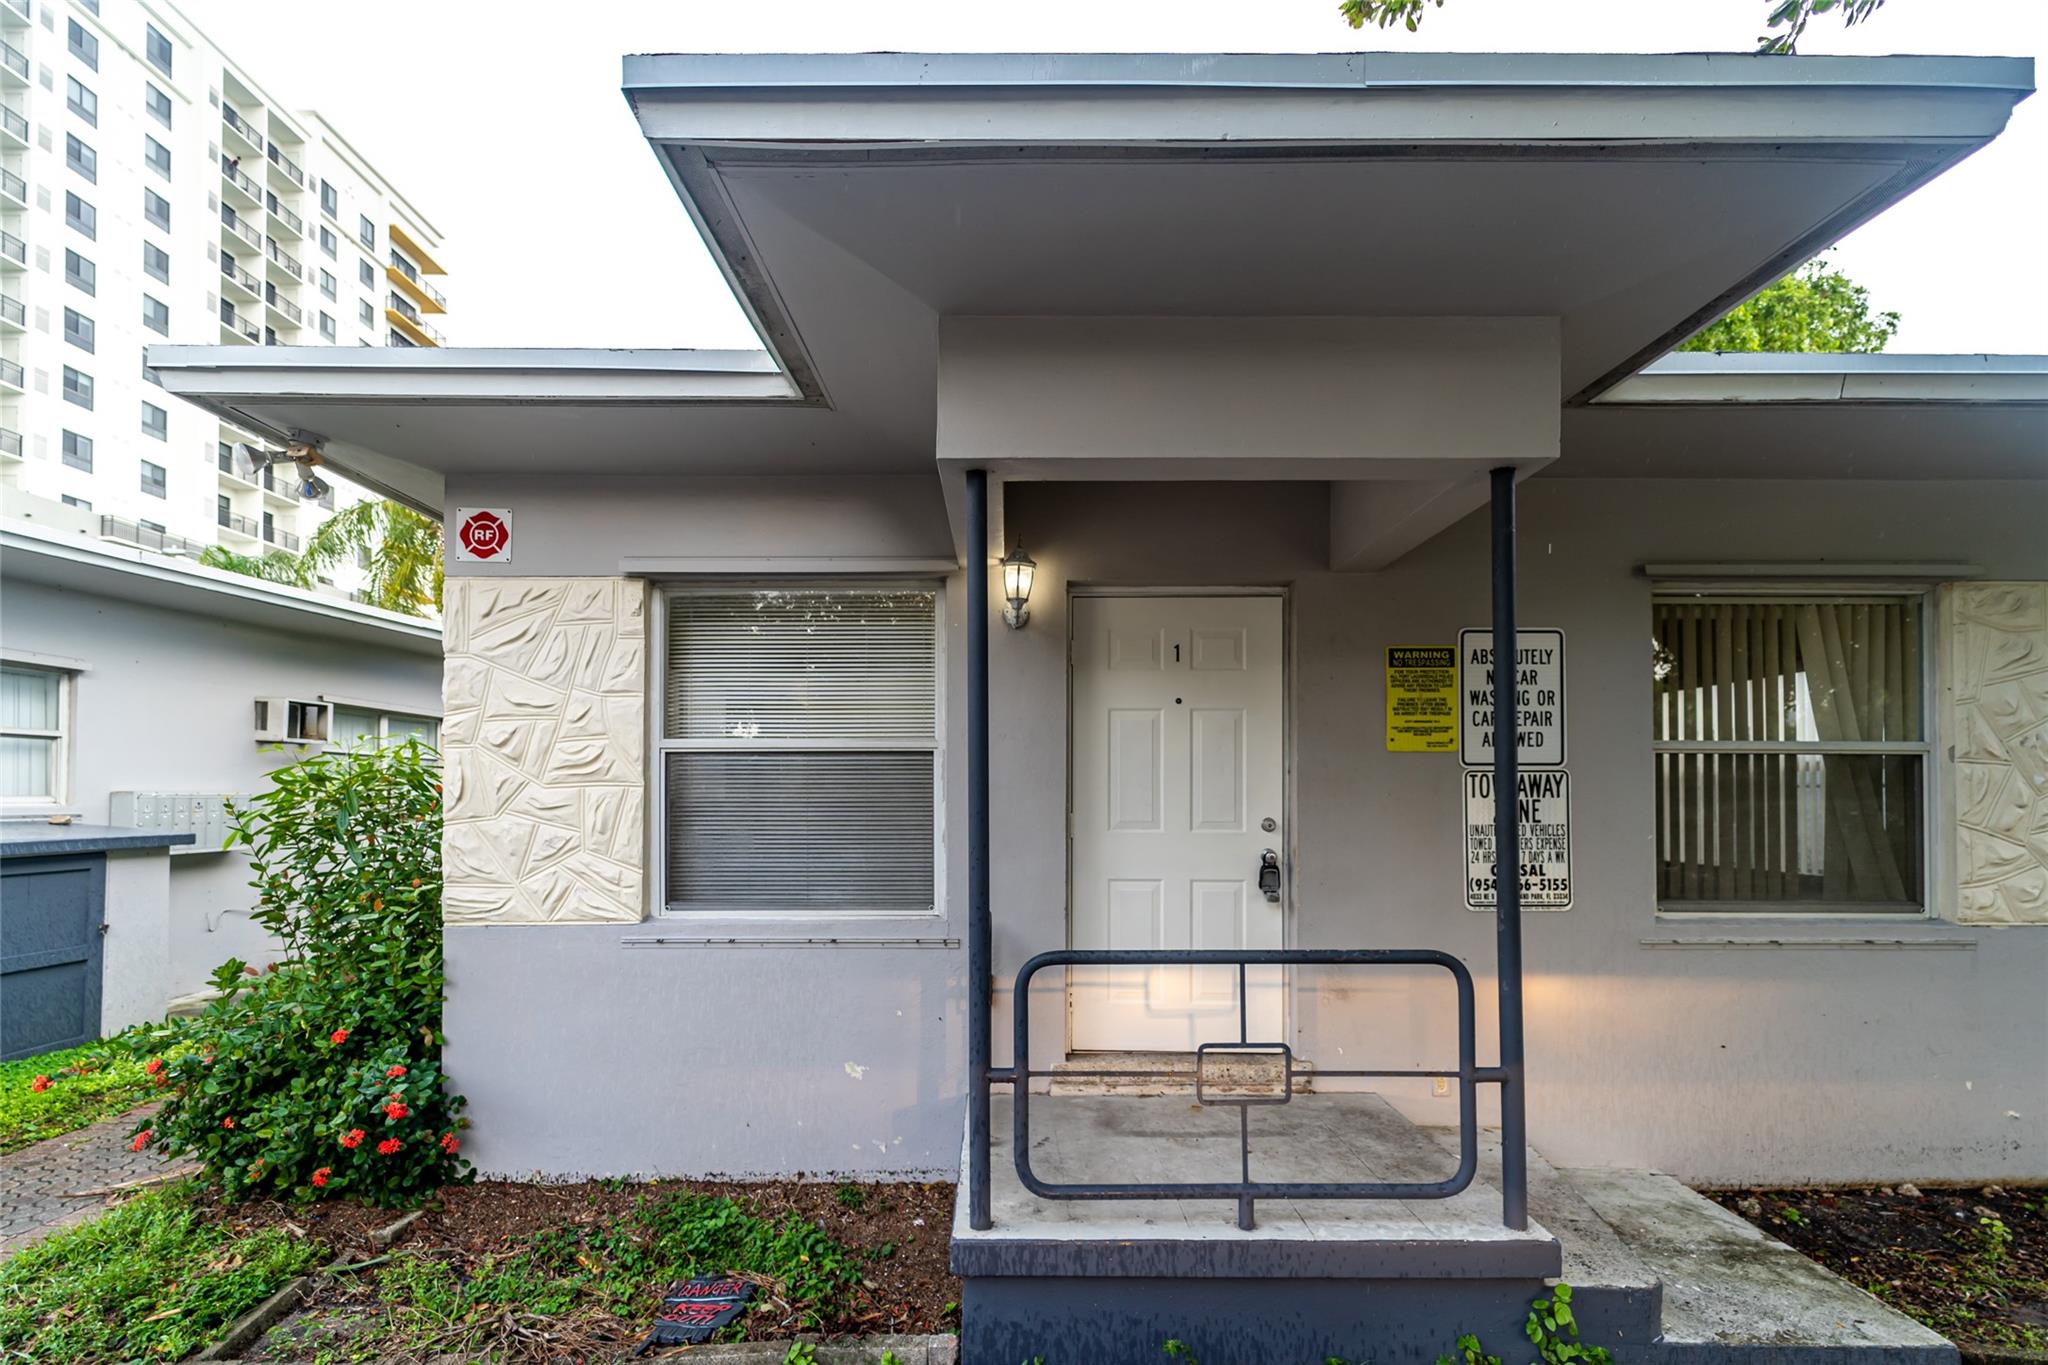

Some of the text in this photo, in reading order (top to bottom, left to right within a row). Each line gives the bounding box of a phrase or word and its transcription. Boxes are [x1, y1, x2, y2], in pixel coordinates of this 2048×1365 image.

[474, 529, 494, 540] RF
[1174, 644, 1180, 662] 1
[1471, 649, 1553, 665] ABSUTELY
[1470, 690, 1555, 706] WASG OR
[1517, 711, 1552, 726] EPAIR
[1482, 732, 1543, 747] AWED
[1469, 774, 1496, 798] TO
[1470, 824, 1566, 837] UNAUTD VEHICLES
[1470, 838, 1492, 850] TOWED
[1536, 838, 1566, 850] EXPENSE
[1471, 851, 1565, 863] 24 HRS 7 DAYS A WK
[1470, 878, 1567, 892] (954 6-5155
[678, 1281, 743, 1297] DANGER
[672, 1303, 732, 1315] KEEP
